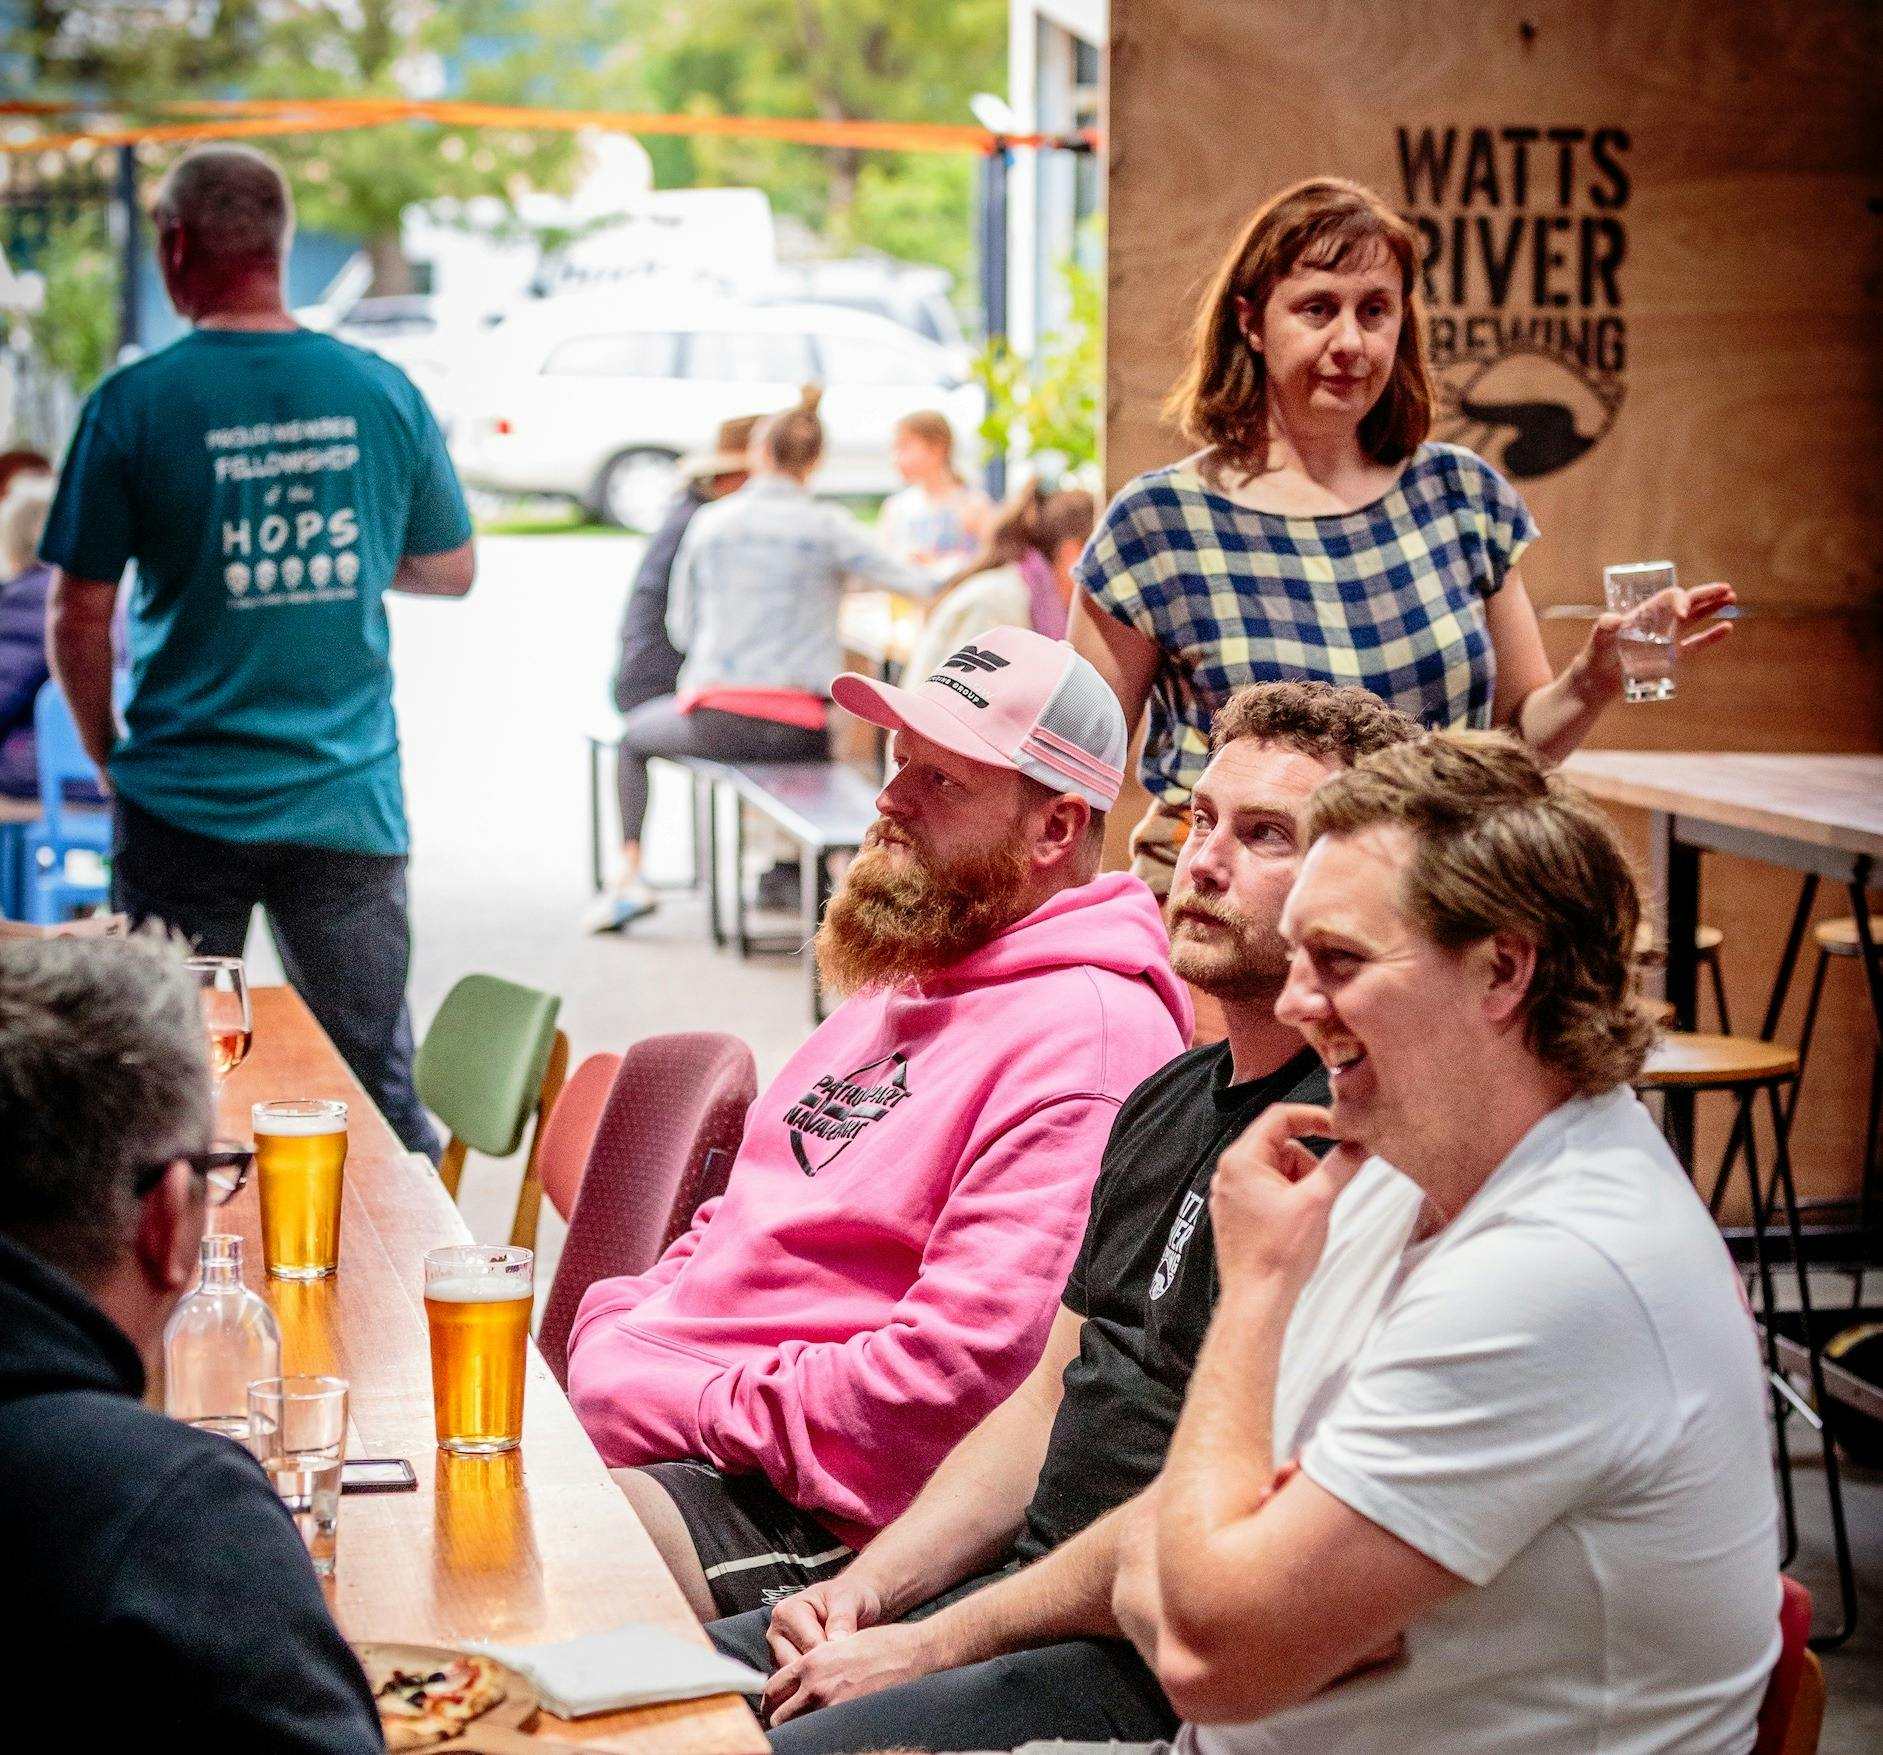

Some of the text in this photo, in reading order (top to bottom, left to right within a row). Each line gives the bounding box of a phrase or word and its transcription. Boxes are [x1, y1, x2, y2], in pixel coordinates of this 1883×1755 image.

[1396, 127, 1632, 209] WATTS
[1429, 315, 1626, 371] REWING
[222, 508, 359, 556] HOPS
[952, 682, 980, 703] GROUP
